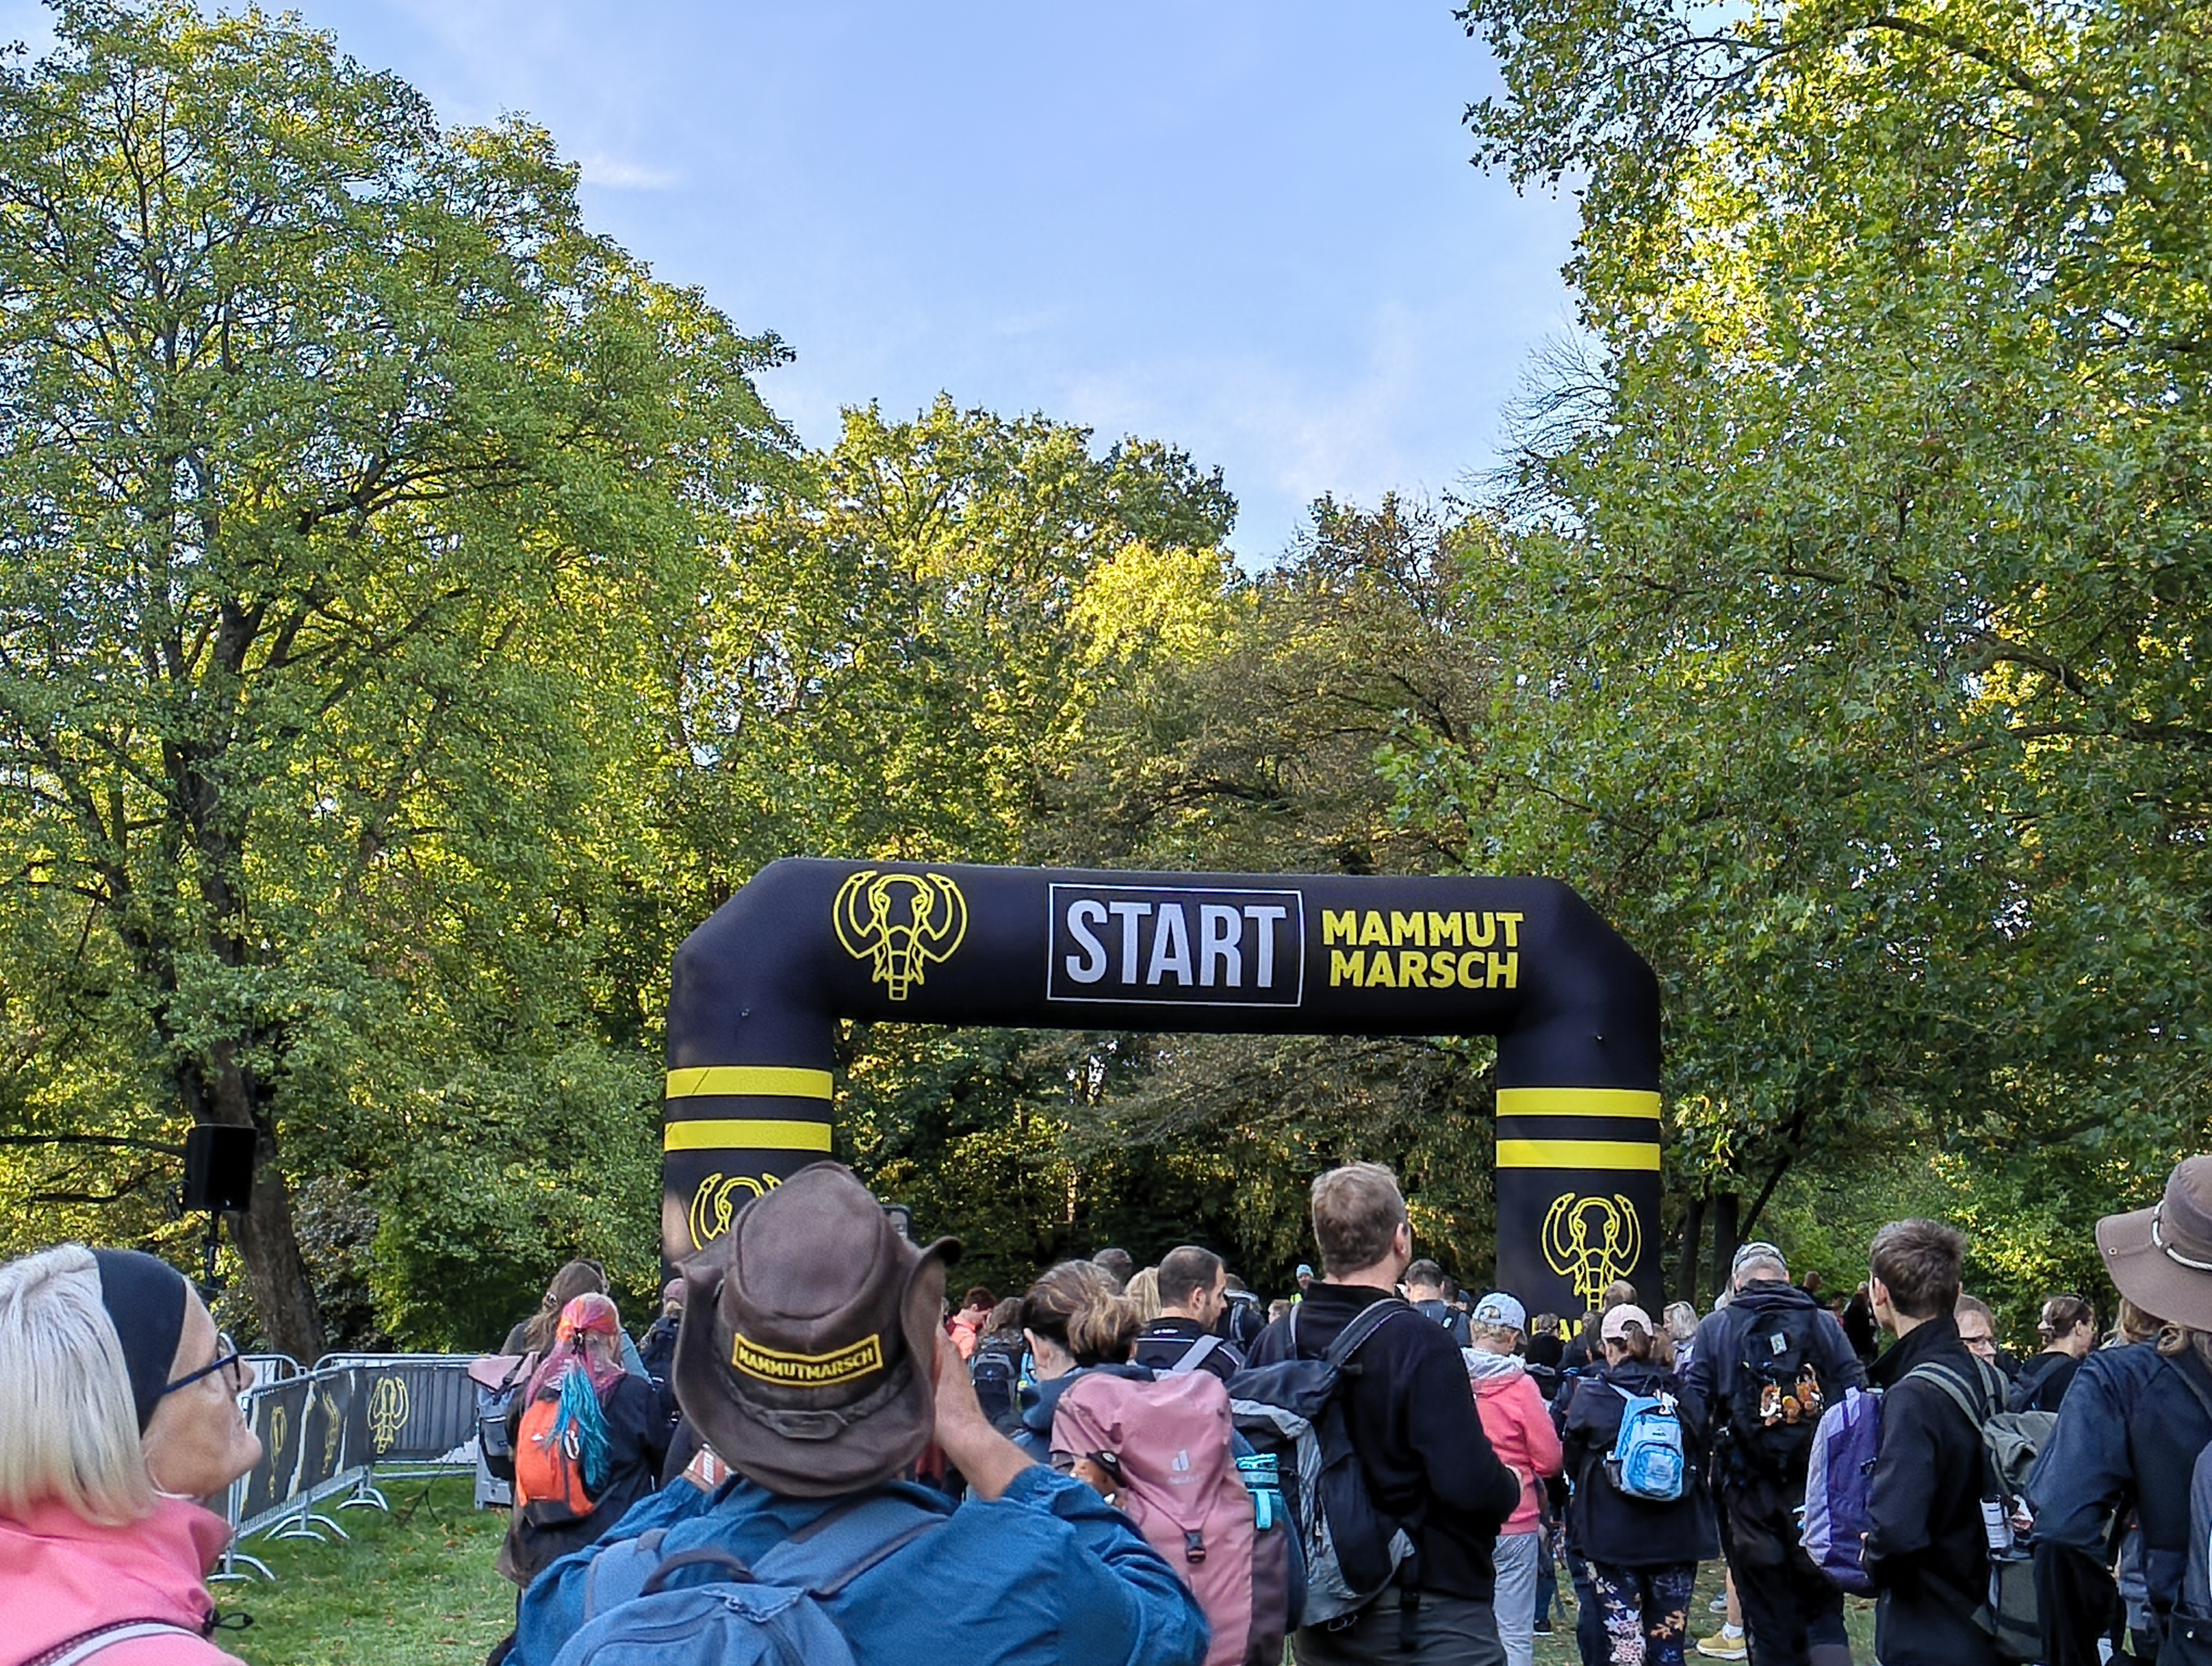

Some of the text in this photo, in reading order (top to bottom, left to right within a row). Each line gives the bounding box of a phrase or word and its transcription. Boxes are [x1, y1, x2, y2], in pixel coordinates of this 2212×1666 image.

[1066, 899, 1287, 988] START
[1322, 909, 1524, 947] MAMMUT
[1329, 950, 1519, 989] MARSCH
[739, 1346, 874, 1379] MAMMUTMARSCH
